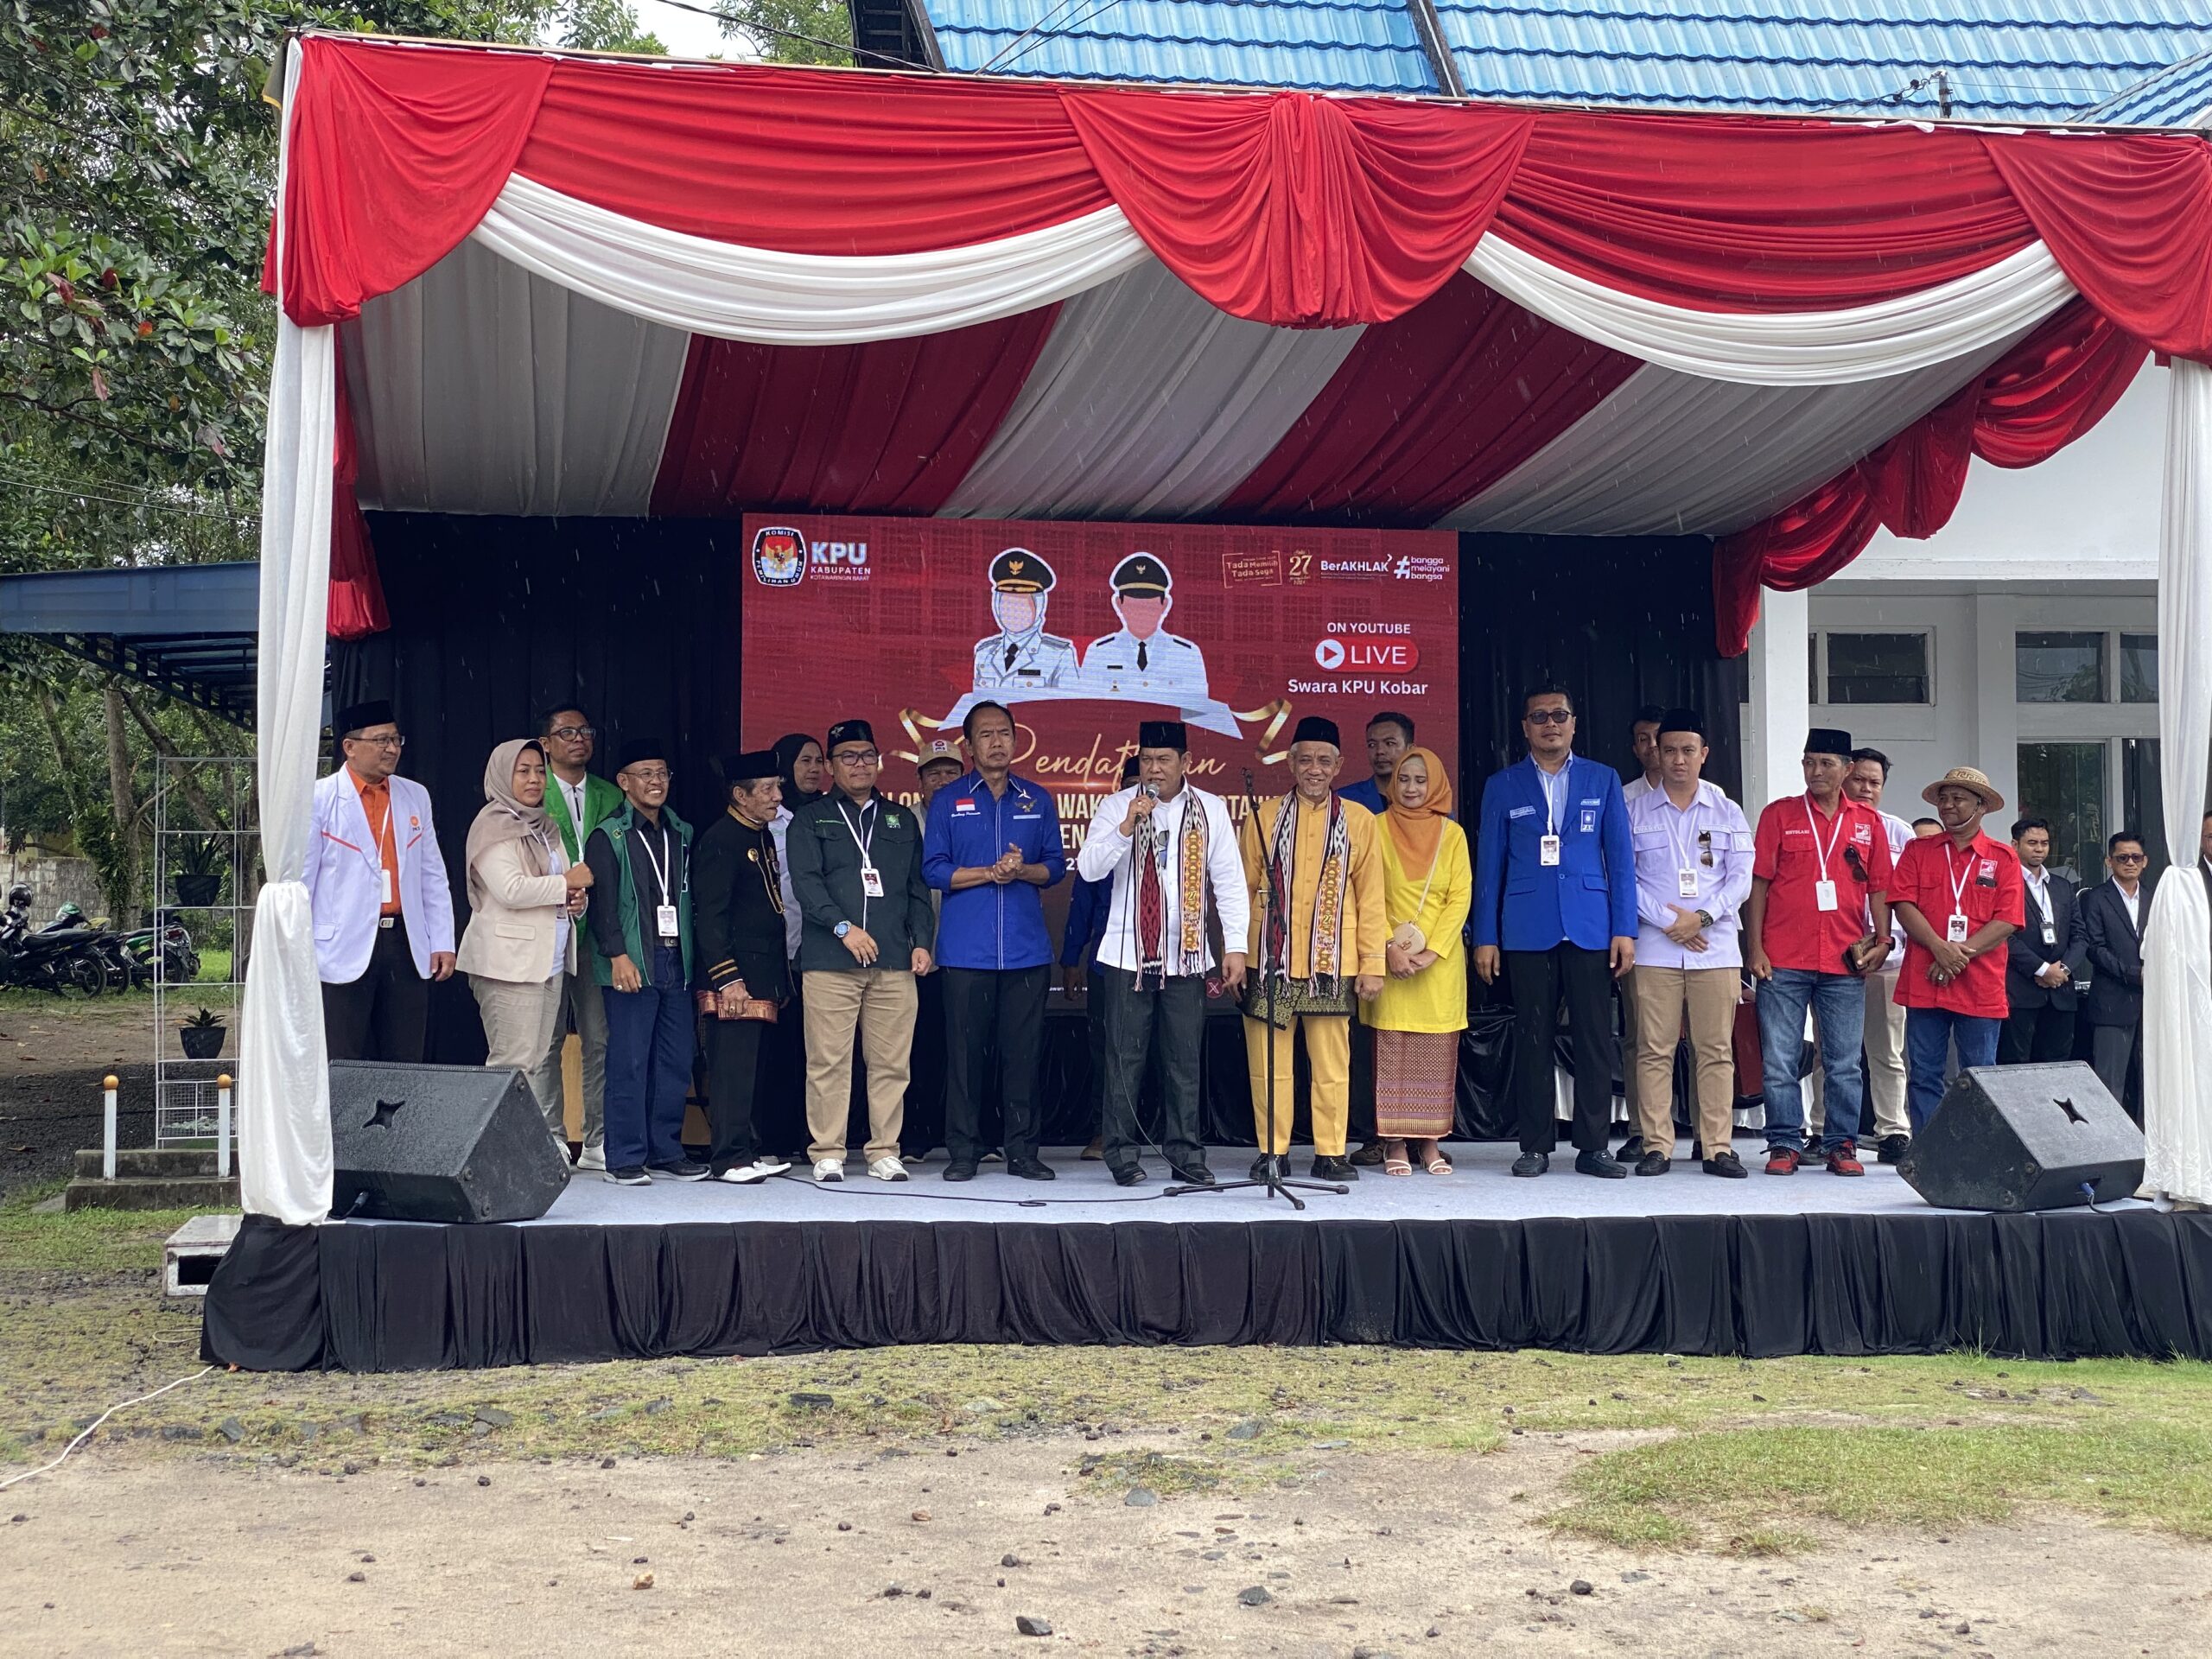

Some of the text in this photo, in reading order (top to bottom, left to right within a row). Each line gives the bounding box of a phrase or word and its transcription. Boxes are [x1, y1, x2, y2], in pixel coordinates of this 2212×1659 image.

[810, 541, 868, 565] KPU
[1289, 556, 1313, 576] 27
[1320, 560, 1389, 572] BerAKHLAK
[1411, 556, 1444, 565] bangga
[810, 566, 871, 575] KABUPATEN
[1411, 564, 1450, 574] melayani
[1411, 573, 1443, 582] bangsa
[1327, 622, 1411, 634] ON YOUTUBE
[1351, 645, 1407, 664] LIVE
[1287, 679, 1428, 695] Swara KPU Kobar
